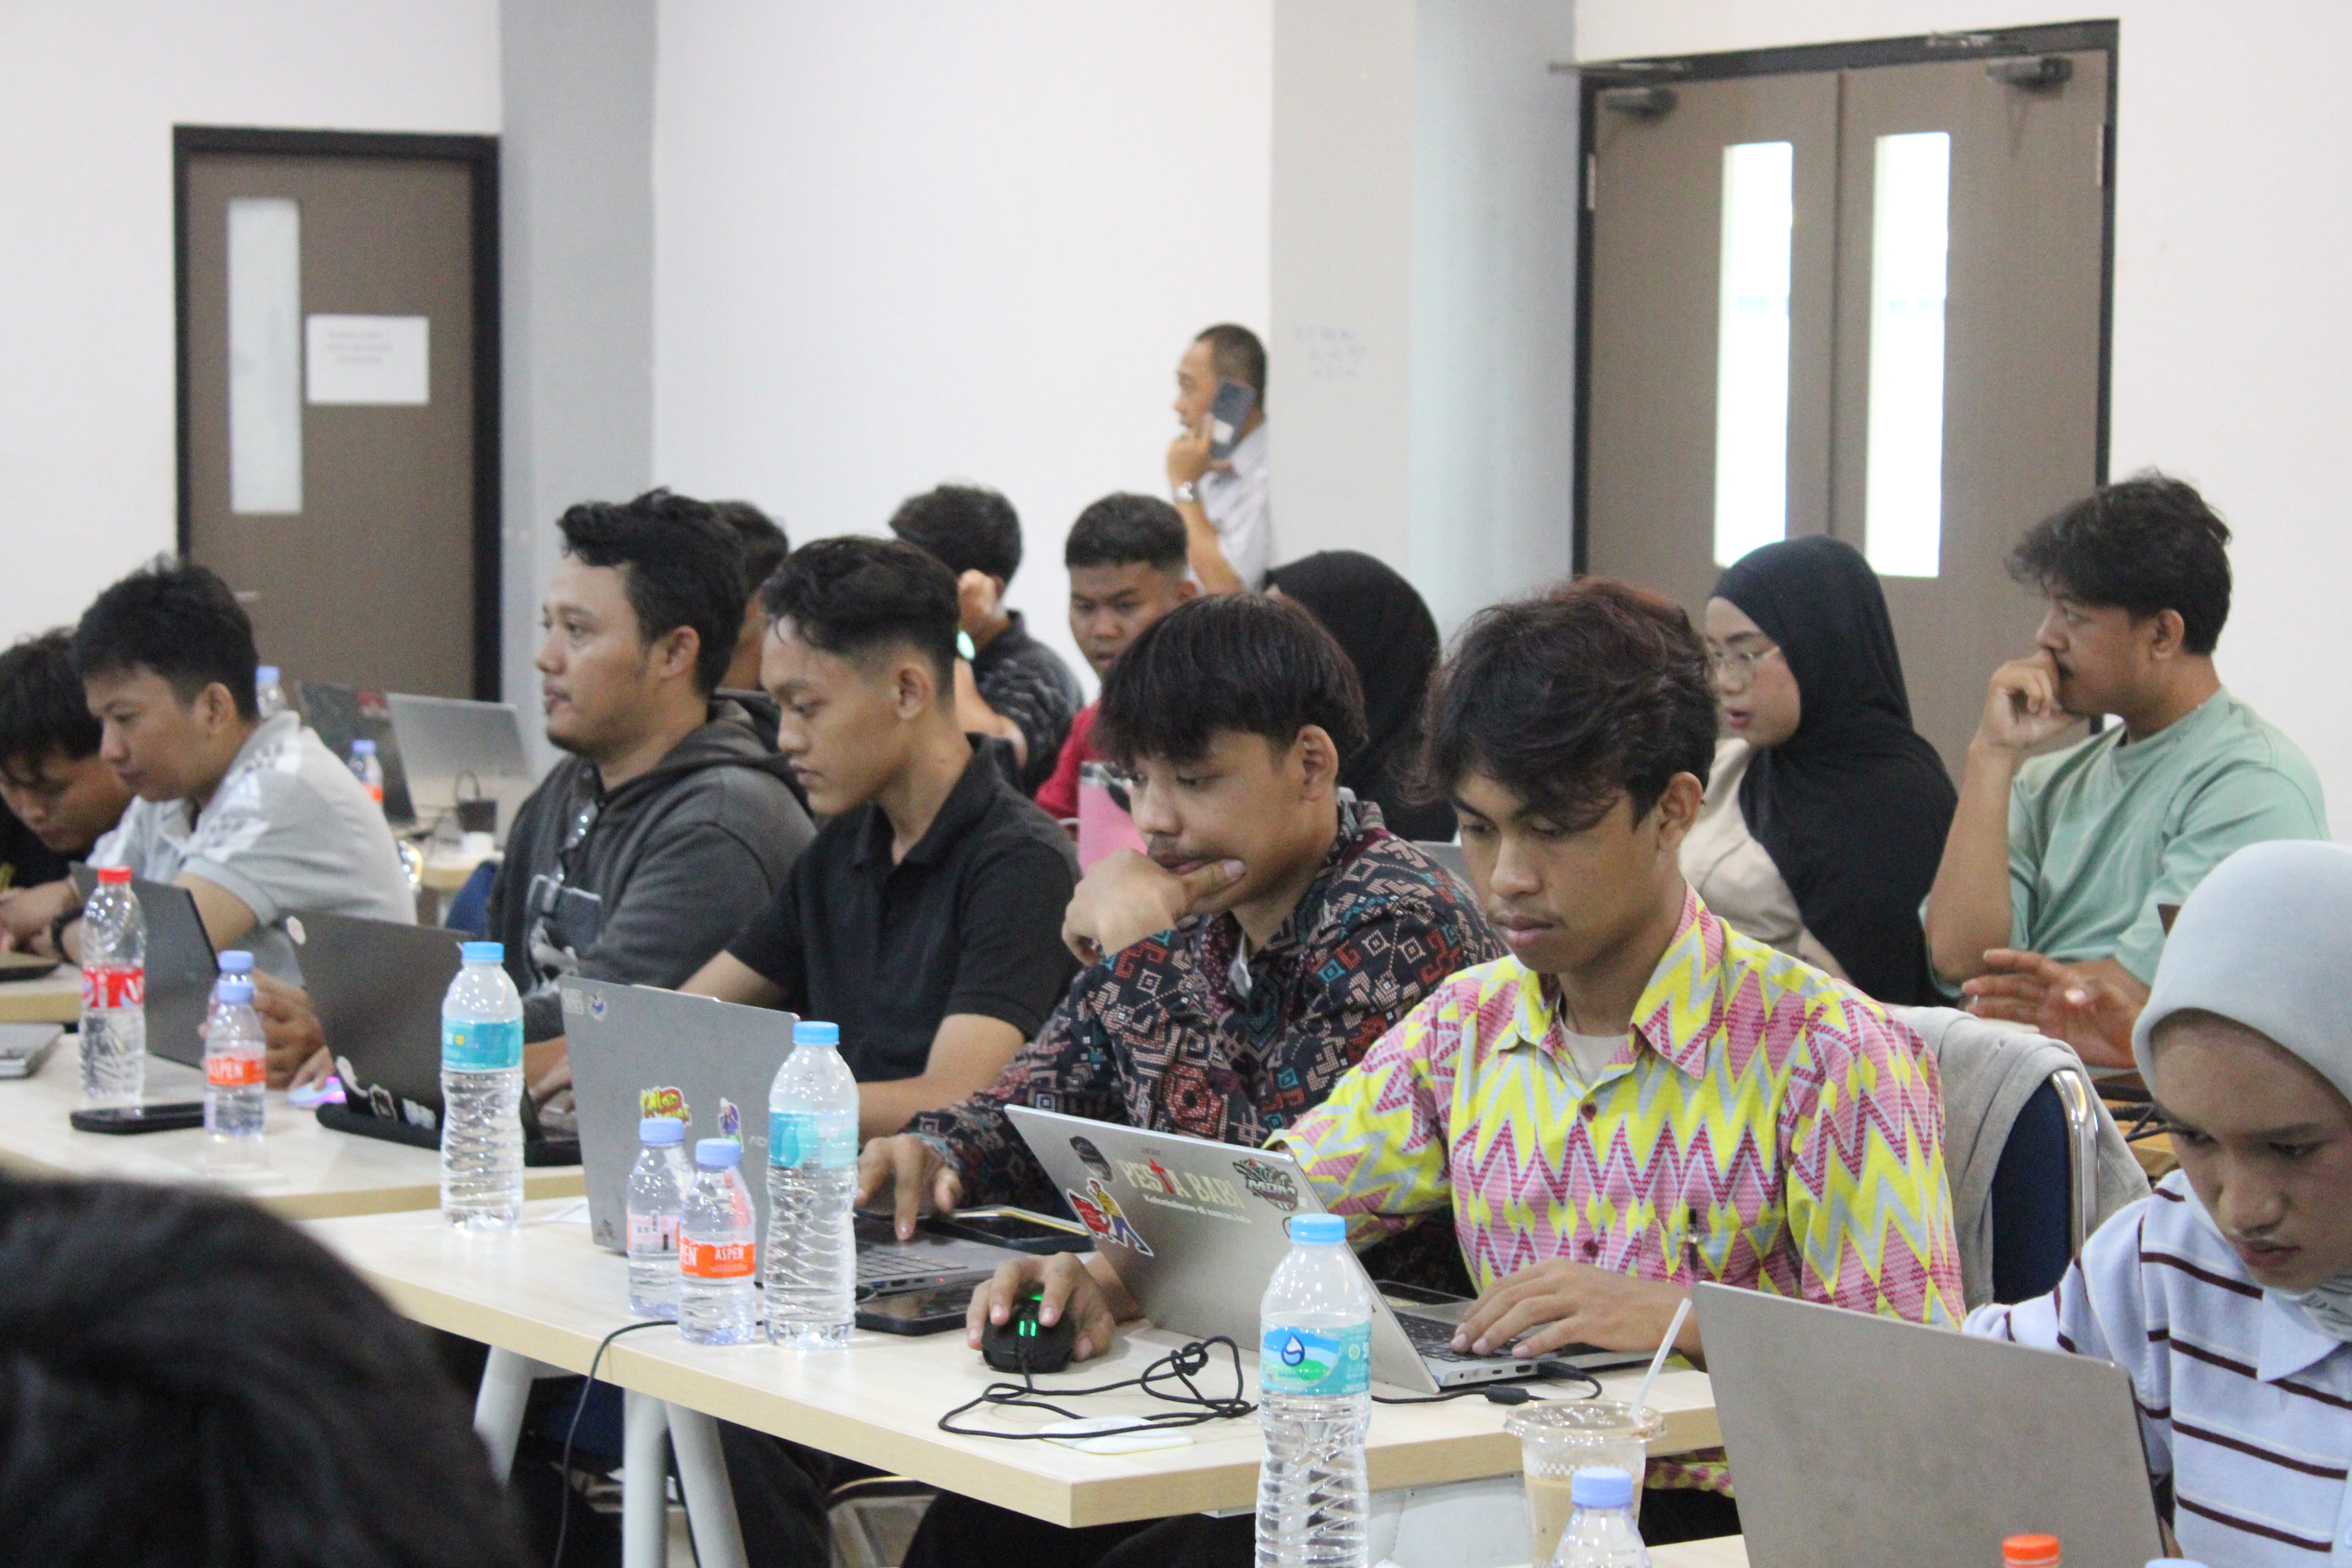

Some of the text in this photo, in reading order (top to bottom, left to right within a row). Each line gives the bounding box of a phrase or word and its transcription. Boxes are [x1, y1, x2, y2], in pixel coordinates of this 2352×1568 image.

[1116, 1158, 1246, 1209] PESTA BABI
[714, 1246, 744, 1260] ASPEN
